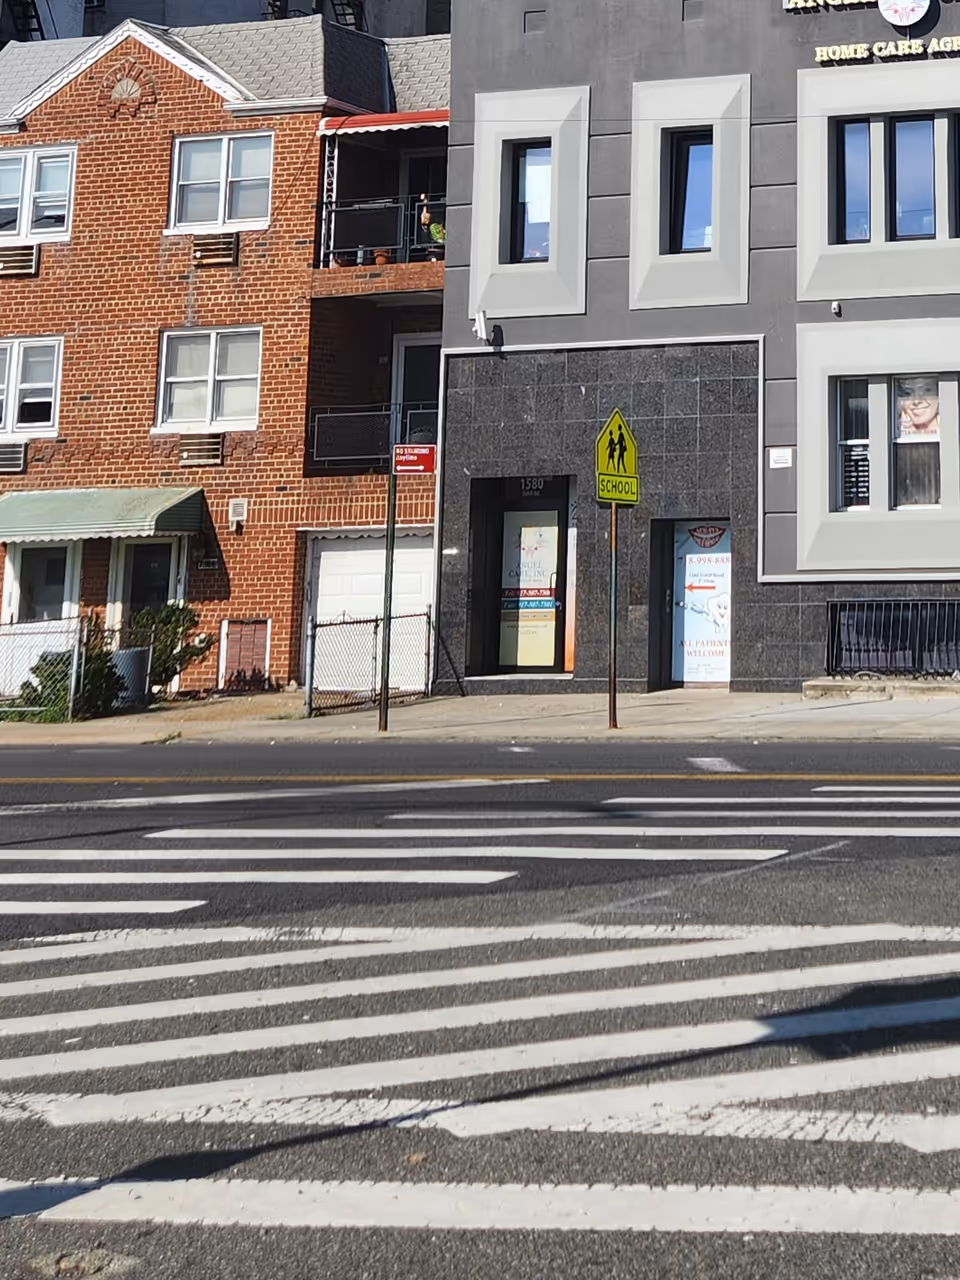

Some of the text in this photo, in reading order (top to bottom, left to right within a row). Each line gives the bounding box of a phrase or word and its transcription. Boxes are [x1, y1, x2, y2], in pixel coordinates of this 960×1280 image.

[814, 43, 869, 62] HOME
[872, 39, 924, 57] CARE
[395, 447, 404, 455] NO
[520, 478, 544, 490] 1580
[600, 478, 636, 496] SCHOOL
